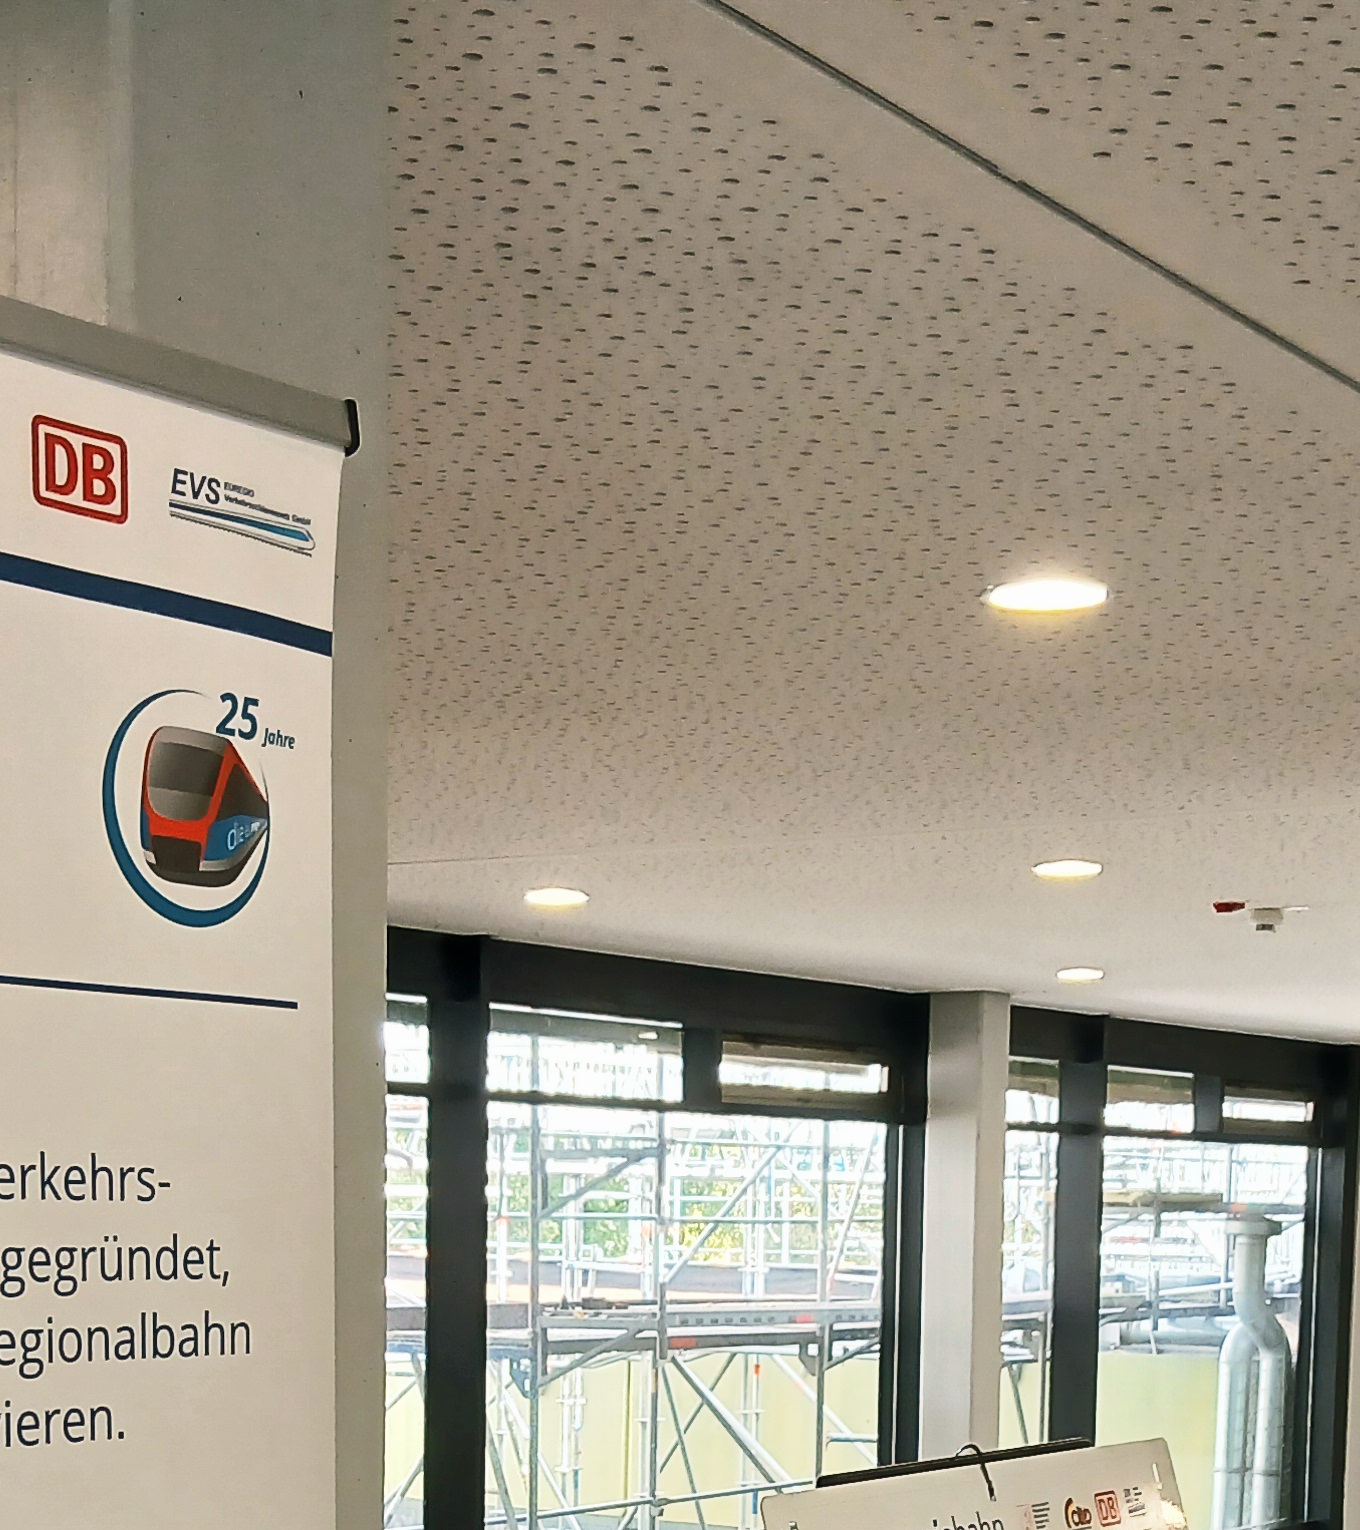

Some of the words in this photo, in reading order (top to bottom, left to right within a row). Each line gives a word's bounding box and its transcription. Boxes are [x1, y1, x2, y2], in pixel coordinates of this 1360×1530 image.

[42, 430, 119, 508] DB
[171, 468, 222, 505] EVS
[215, 692, 260, 741] 25
[261, 727, 296, 750] Jahre
[0, 1233, 231, 1298] gegründet,
[1095, 1493, 1120, 1524] DB
